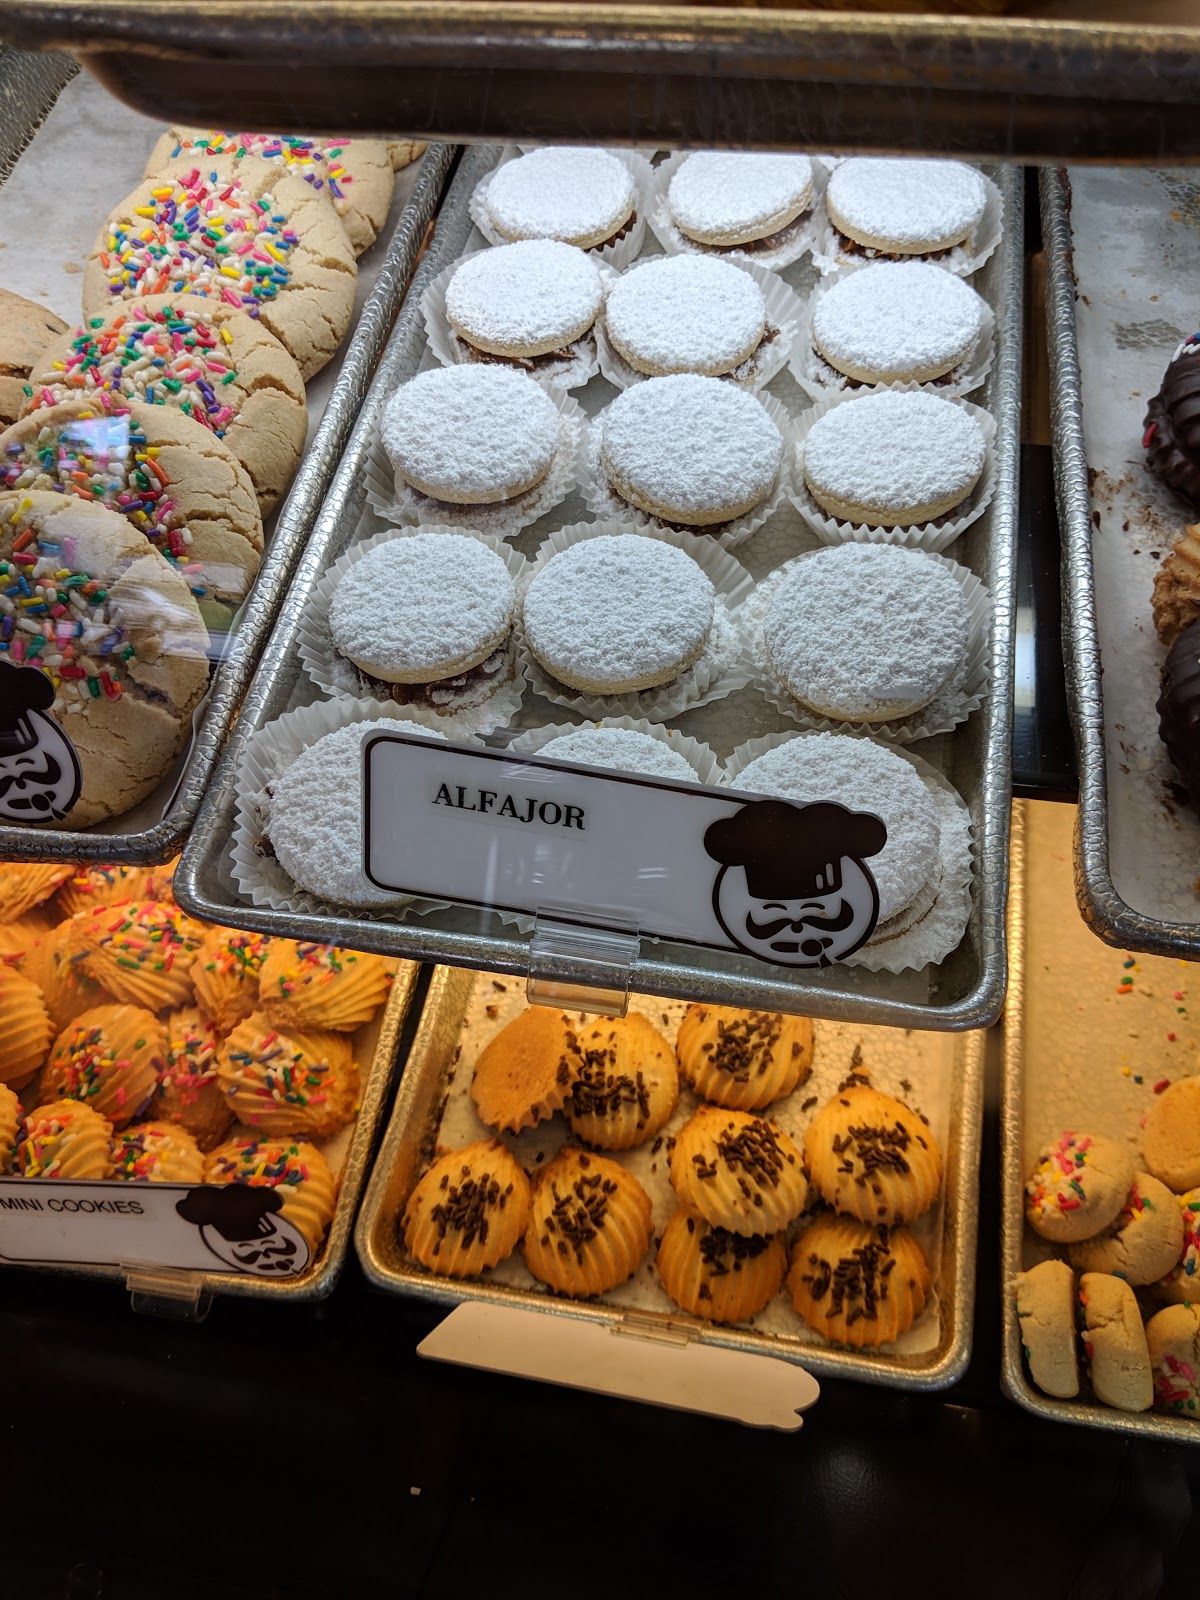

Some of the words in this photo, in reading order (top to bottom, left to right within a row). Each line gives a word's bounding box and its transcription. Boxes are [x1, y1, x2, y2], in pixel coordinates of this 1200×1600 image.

[432, 782, 586, 830] ALFAJOR
[0, 1197, 43, 1211] MINI
[48, 1199, 144, 1215] COOKIES
